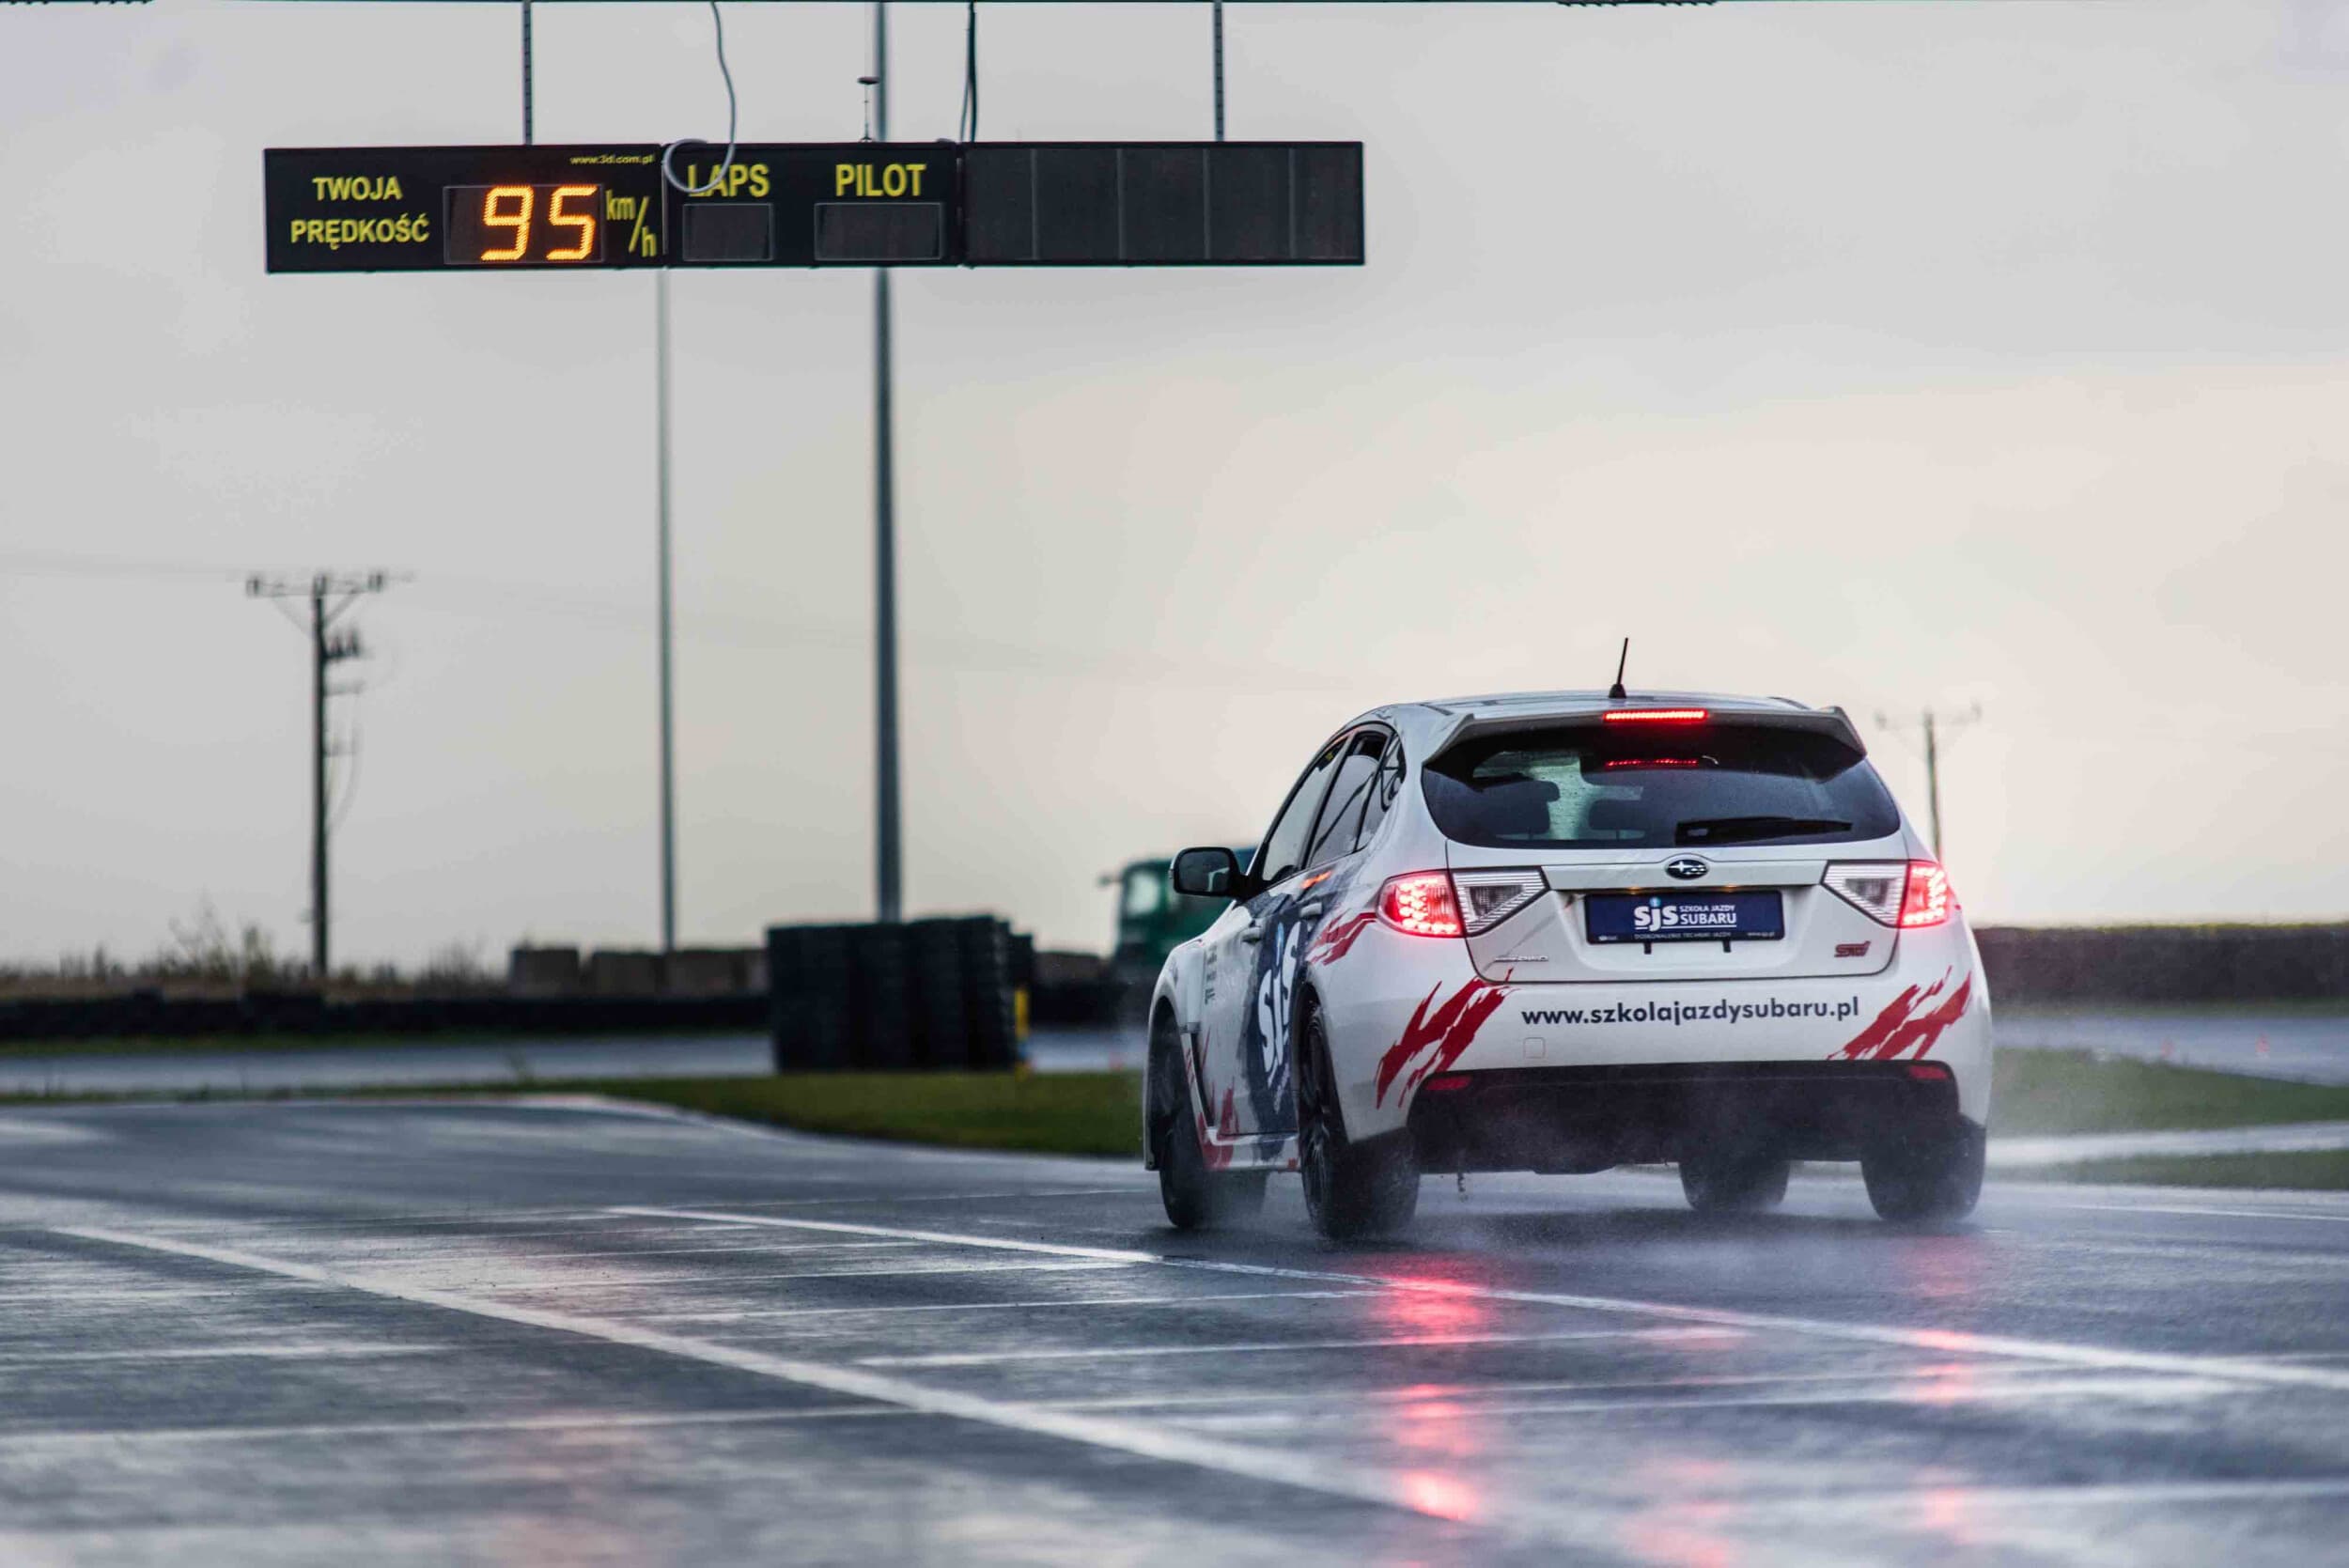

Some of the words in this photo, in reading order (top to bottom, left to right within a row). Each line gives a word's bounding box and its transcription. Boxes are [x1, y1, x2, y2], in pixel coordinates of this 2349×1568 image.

[313, 176, 403, 201] TWOJA
[688, 163, 770, 197] LAPS
[835, 163, 927, 197] PILOT
[290, 213, 429, 250] PRĘDKOŚĆ
[480, 184, 599, 261] 95
[1679, 912, 1737, 925] SUBARU
[1711, 904, 1736, 912] JAZDY
[1521, 996, 1859, 1025] www.szkolajazdysubaru.pl
